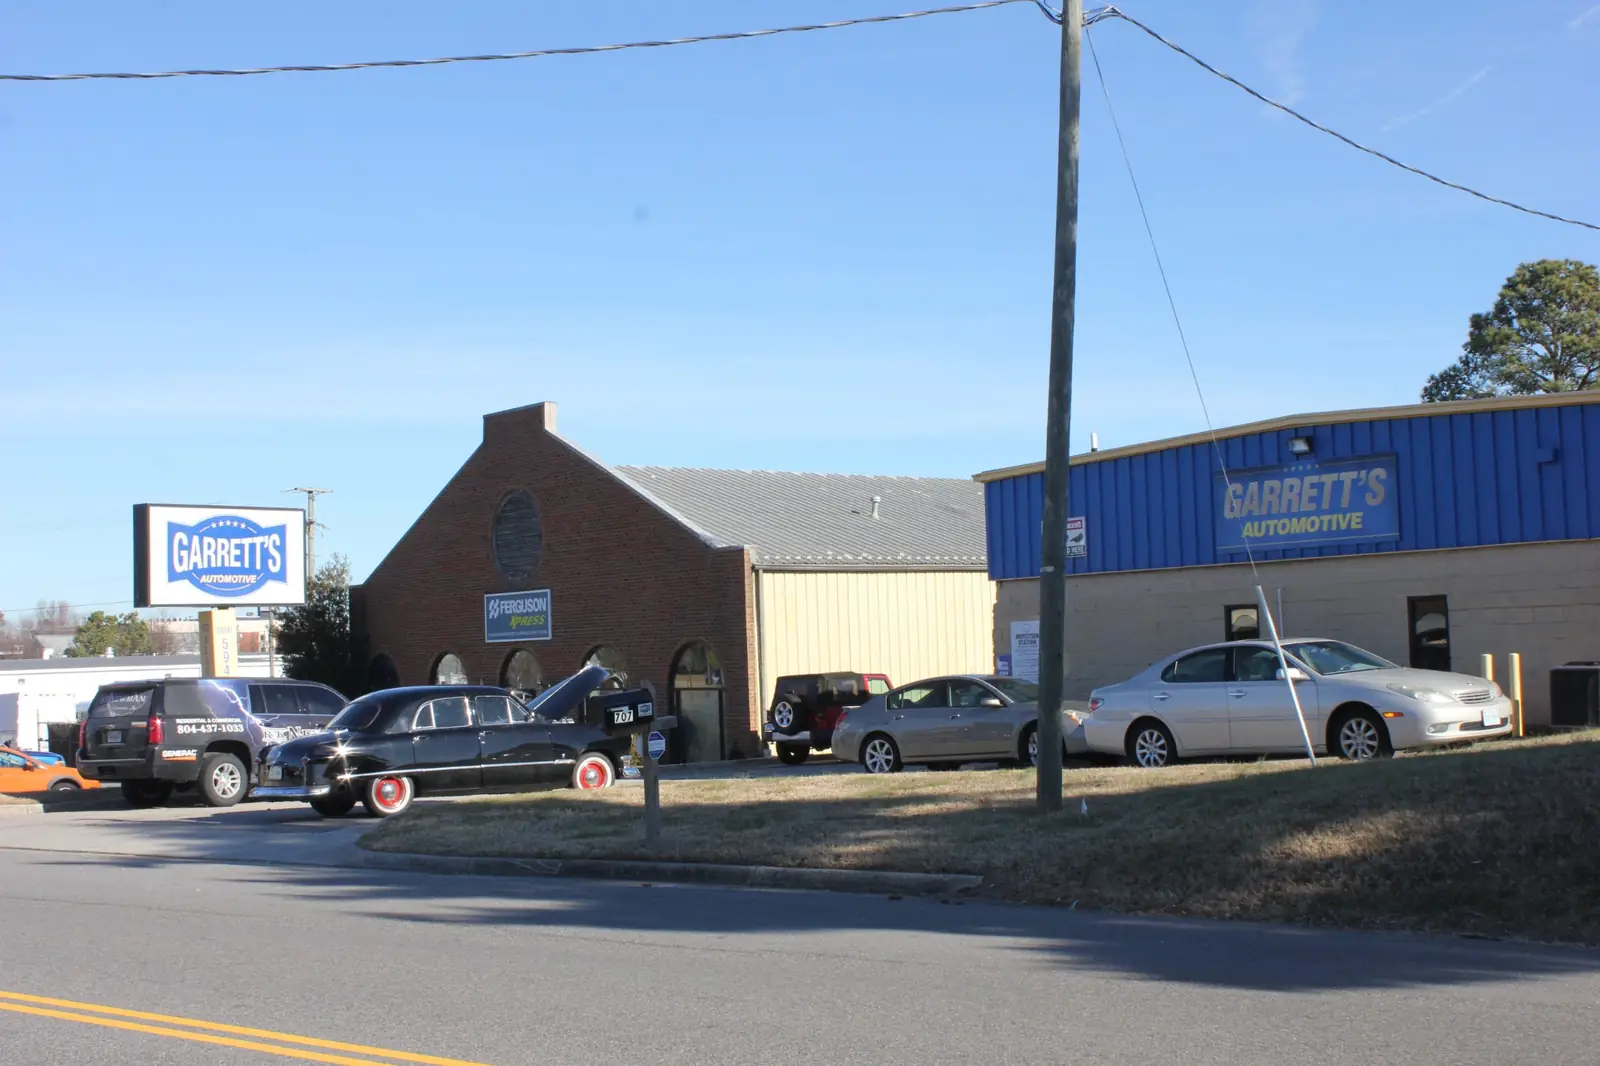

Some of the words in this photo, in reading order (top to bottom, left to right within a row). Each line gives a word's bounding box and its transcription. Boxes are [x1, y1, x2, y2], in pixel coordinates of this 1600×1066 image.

[1224, 467, 1388, 520] GARRETT'S
[1241, 511, 1364, 538] AUTOMOTIVE
[173, 531, 281, 573] GARRETT'S
[200, 574, 257, 584] AUTOMOTIVE
[500, 598, 547, 614] FERGUSON
[509, 614, 546, 629] XPRESS
[615, 711, 632, 723] 707
[177, 724, 244, 734] 804-437-1033
[162, 749, 197, 758] GENERAC
